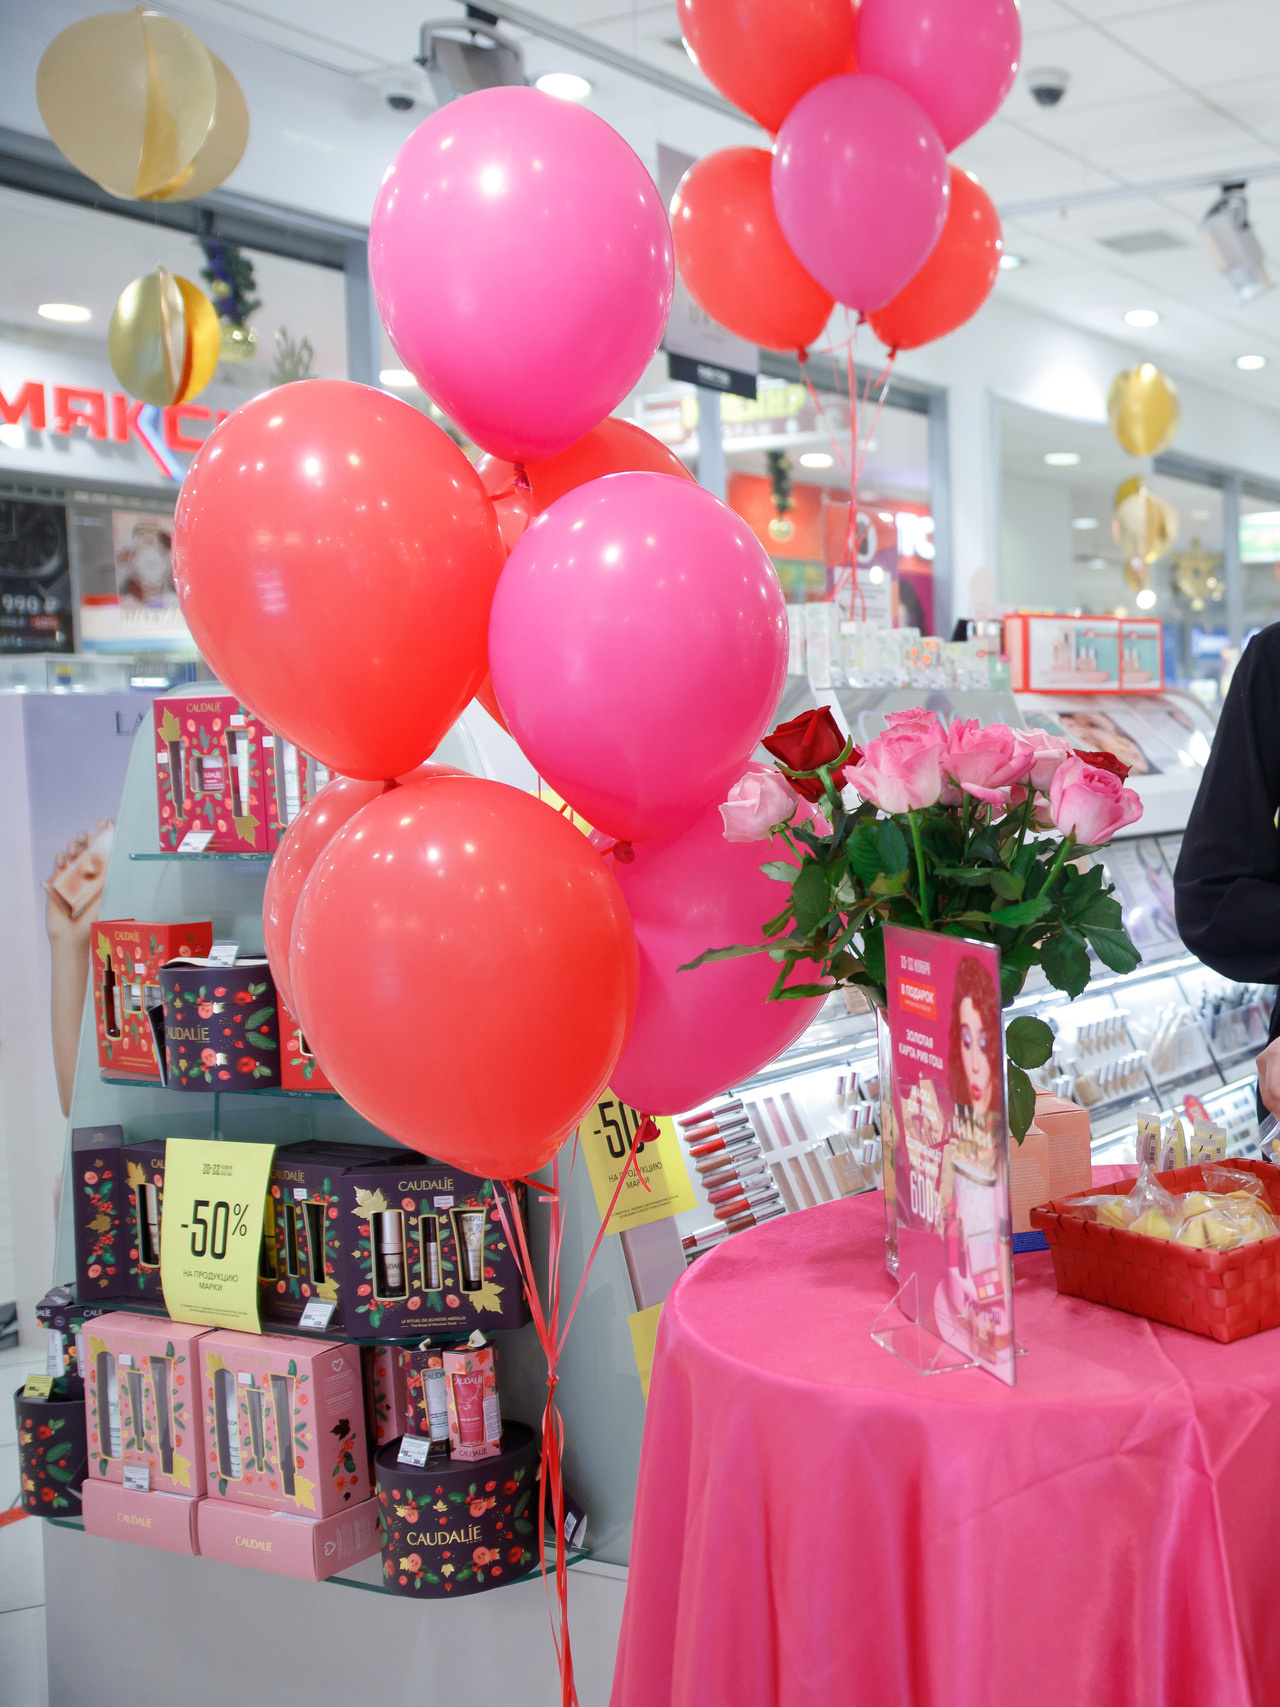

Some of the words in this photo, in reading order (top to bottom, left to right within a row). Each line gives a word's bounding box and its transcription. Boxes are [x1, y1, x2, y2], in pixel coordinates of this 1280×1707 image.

[0, 381, 229, 479] МАКС
[608, 1174, 619, 1183] НА
[181, 1199, 249, 1260] -50%
[183, 1269, 192, 1277] НА
[194, 1270, 238, 1283] ПРОДУКЦИЮ
[199, 1282, 223, 1291] МАРКИ
